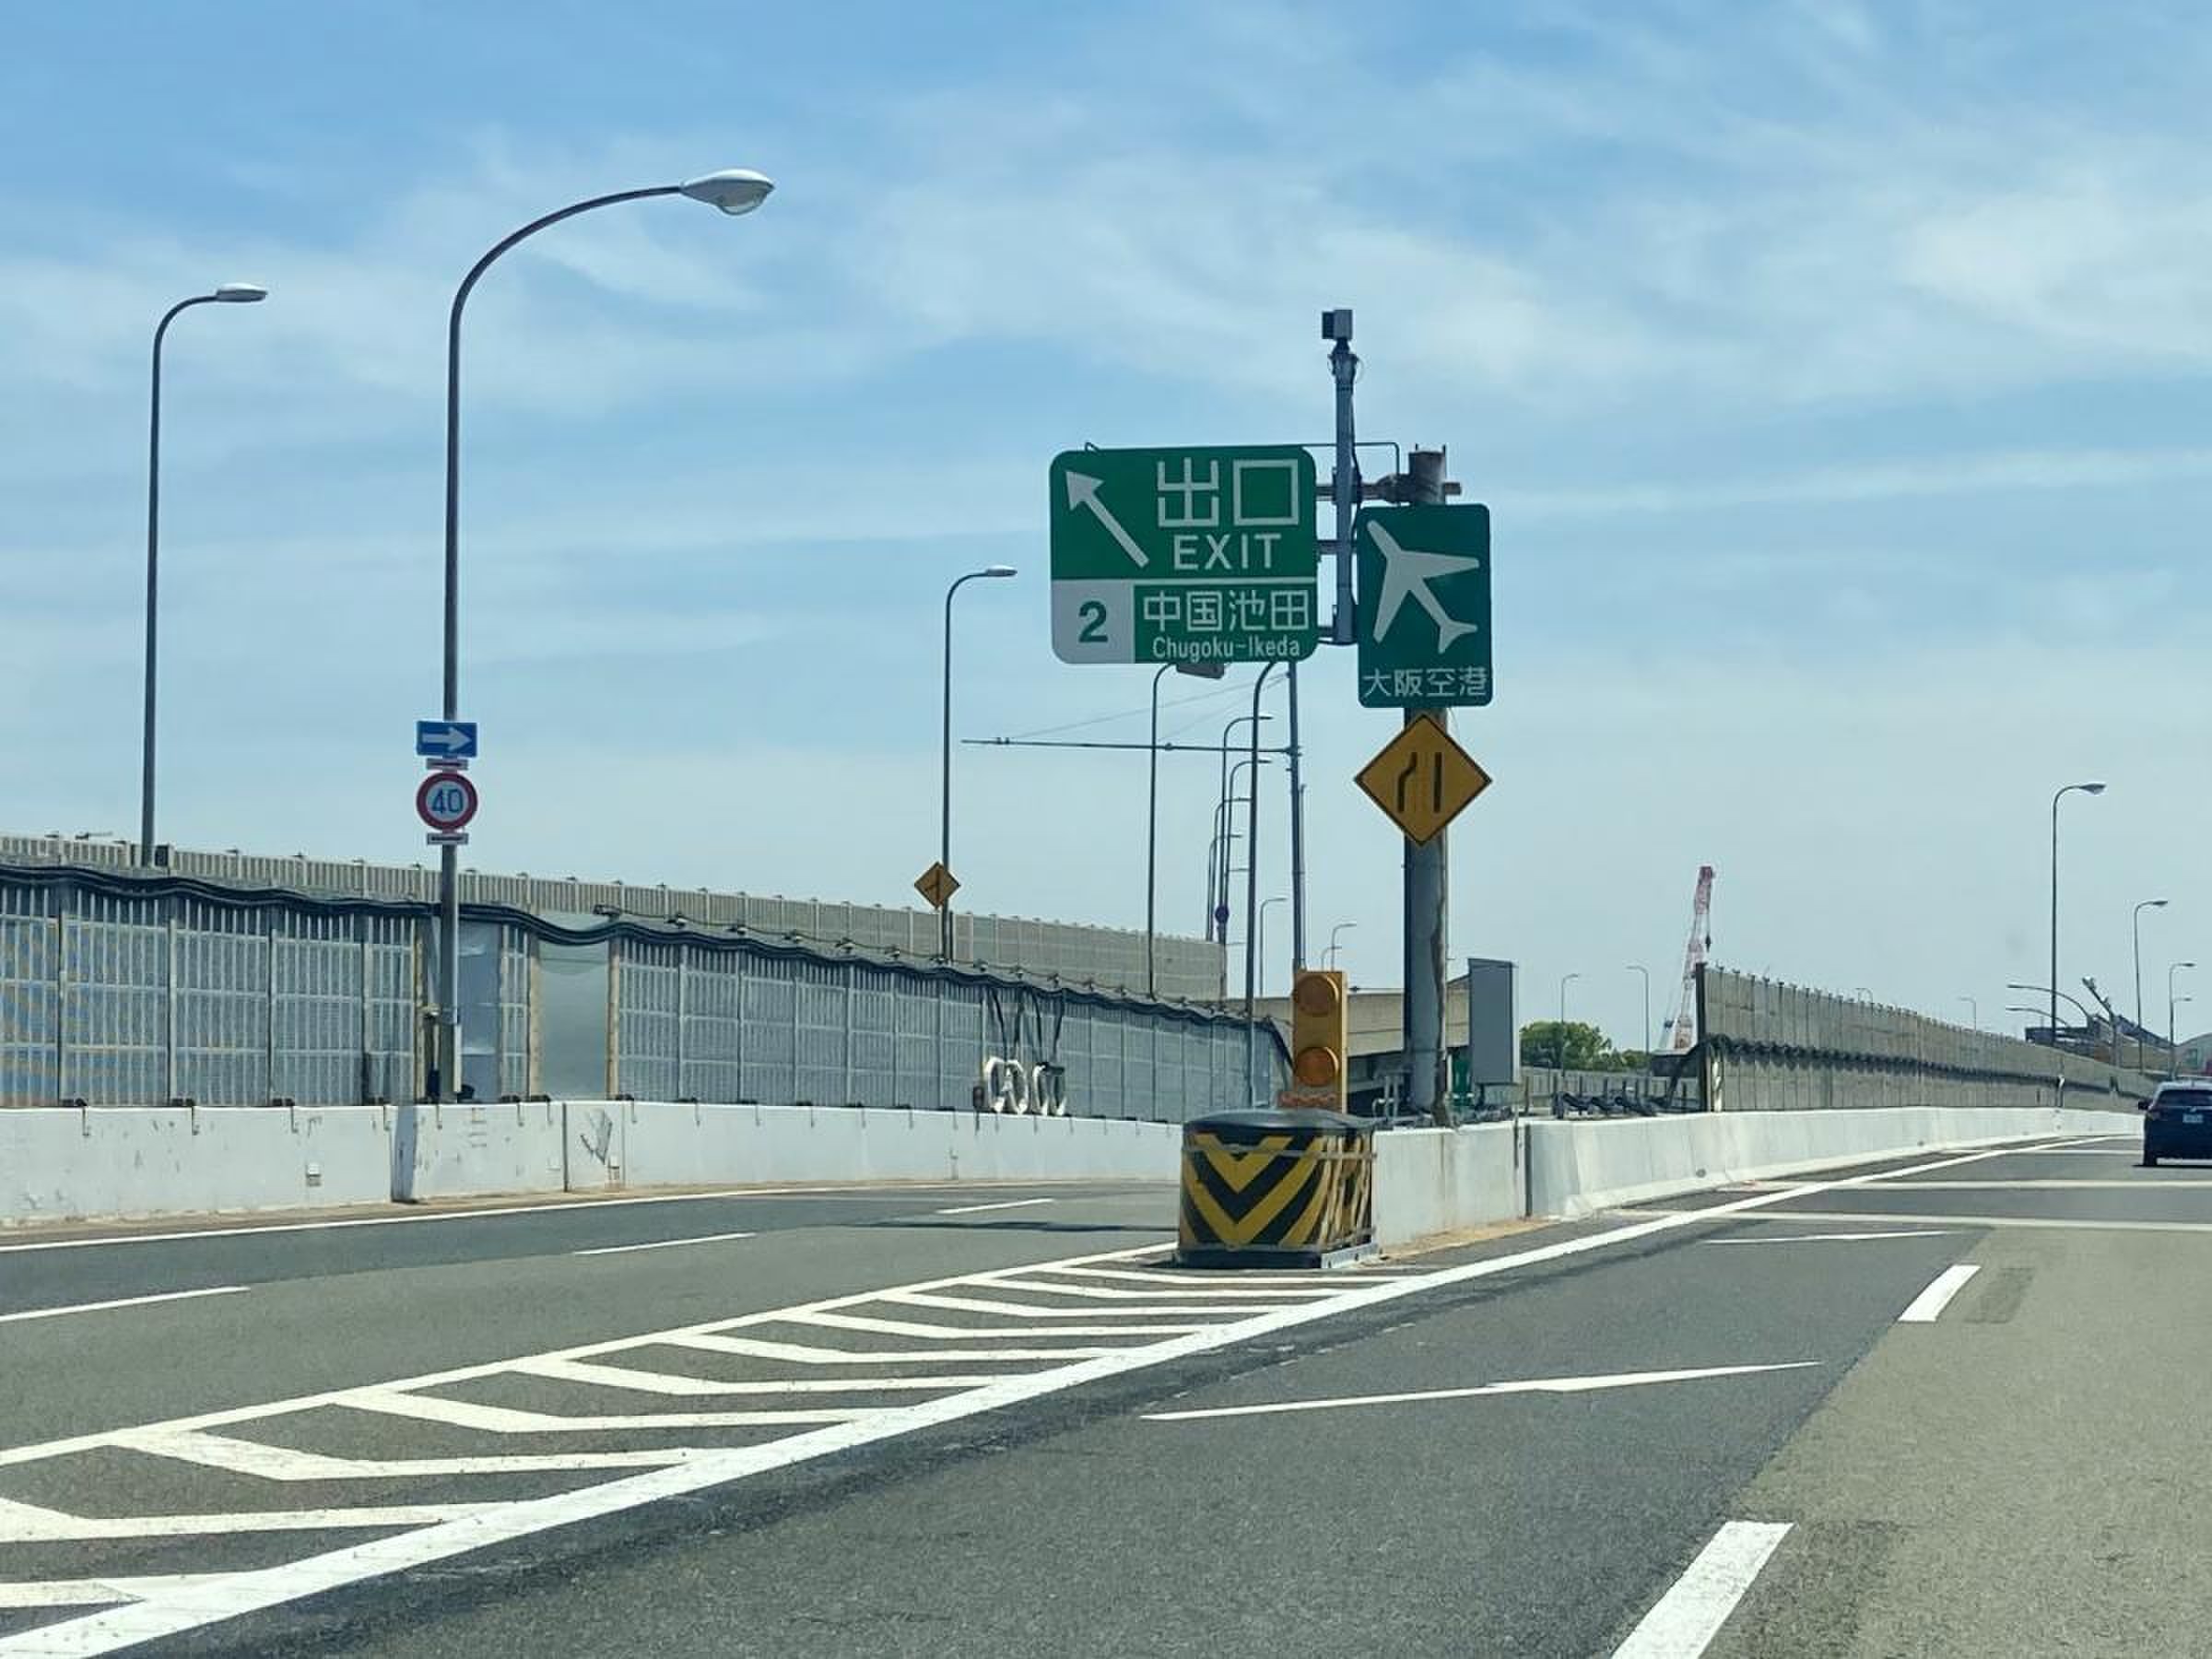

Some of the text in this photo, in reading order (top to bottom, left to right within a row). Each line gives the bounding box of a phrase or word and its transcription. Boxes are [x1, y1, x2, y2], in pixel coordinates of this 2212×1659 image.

[1157, 457, 1299, 527] 出口
[1173, 534, 1281, 570] EXIT
[1078, 601, 1109, 642] 2
[1144, 590, 1309, 632] 中国池田
[1152, 637, 1300, 663] Chugoku-Ikeda
[1363, 666, 1488, 698] 大阪空港
[431, 788, 464, 813] 40
